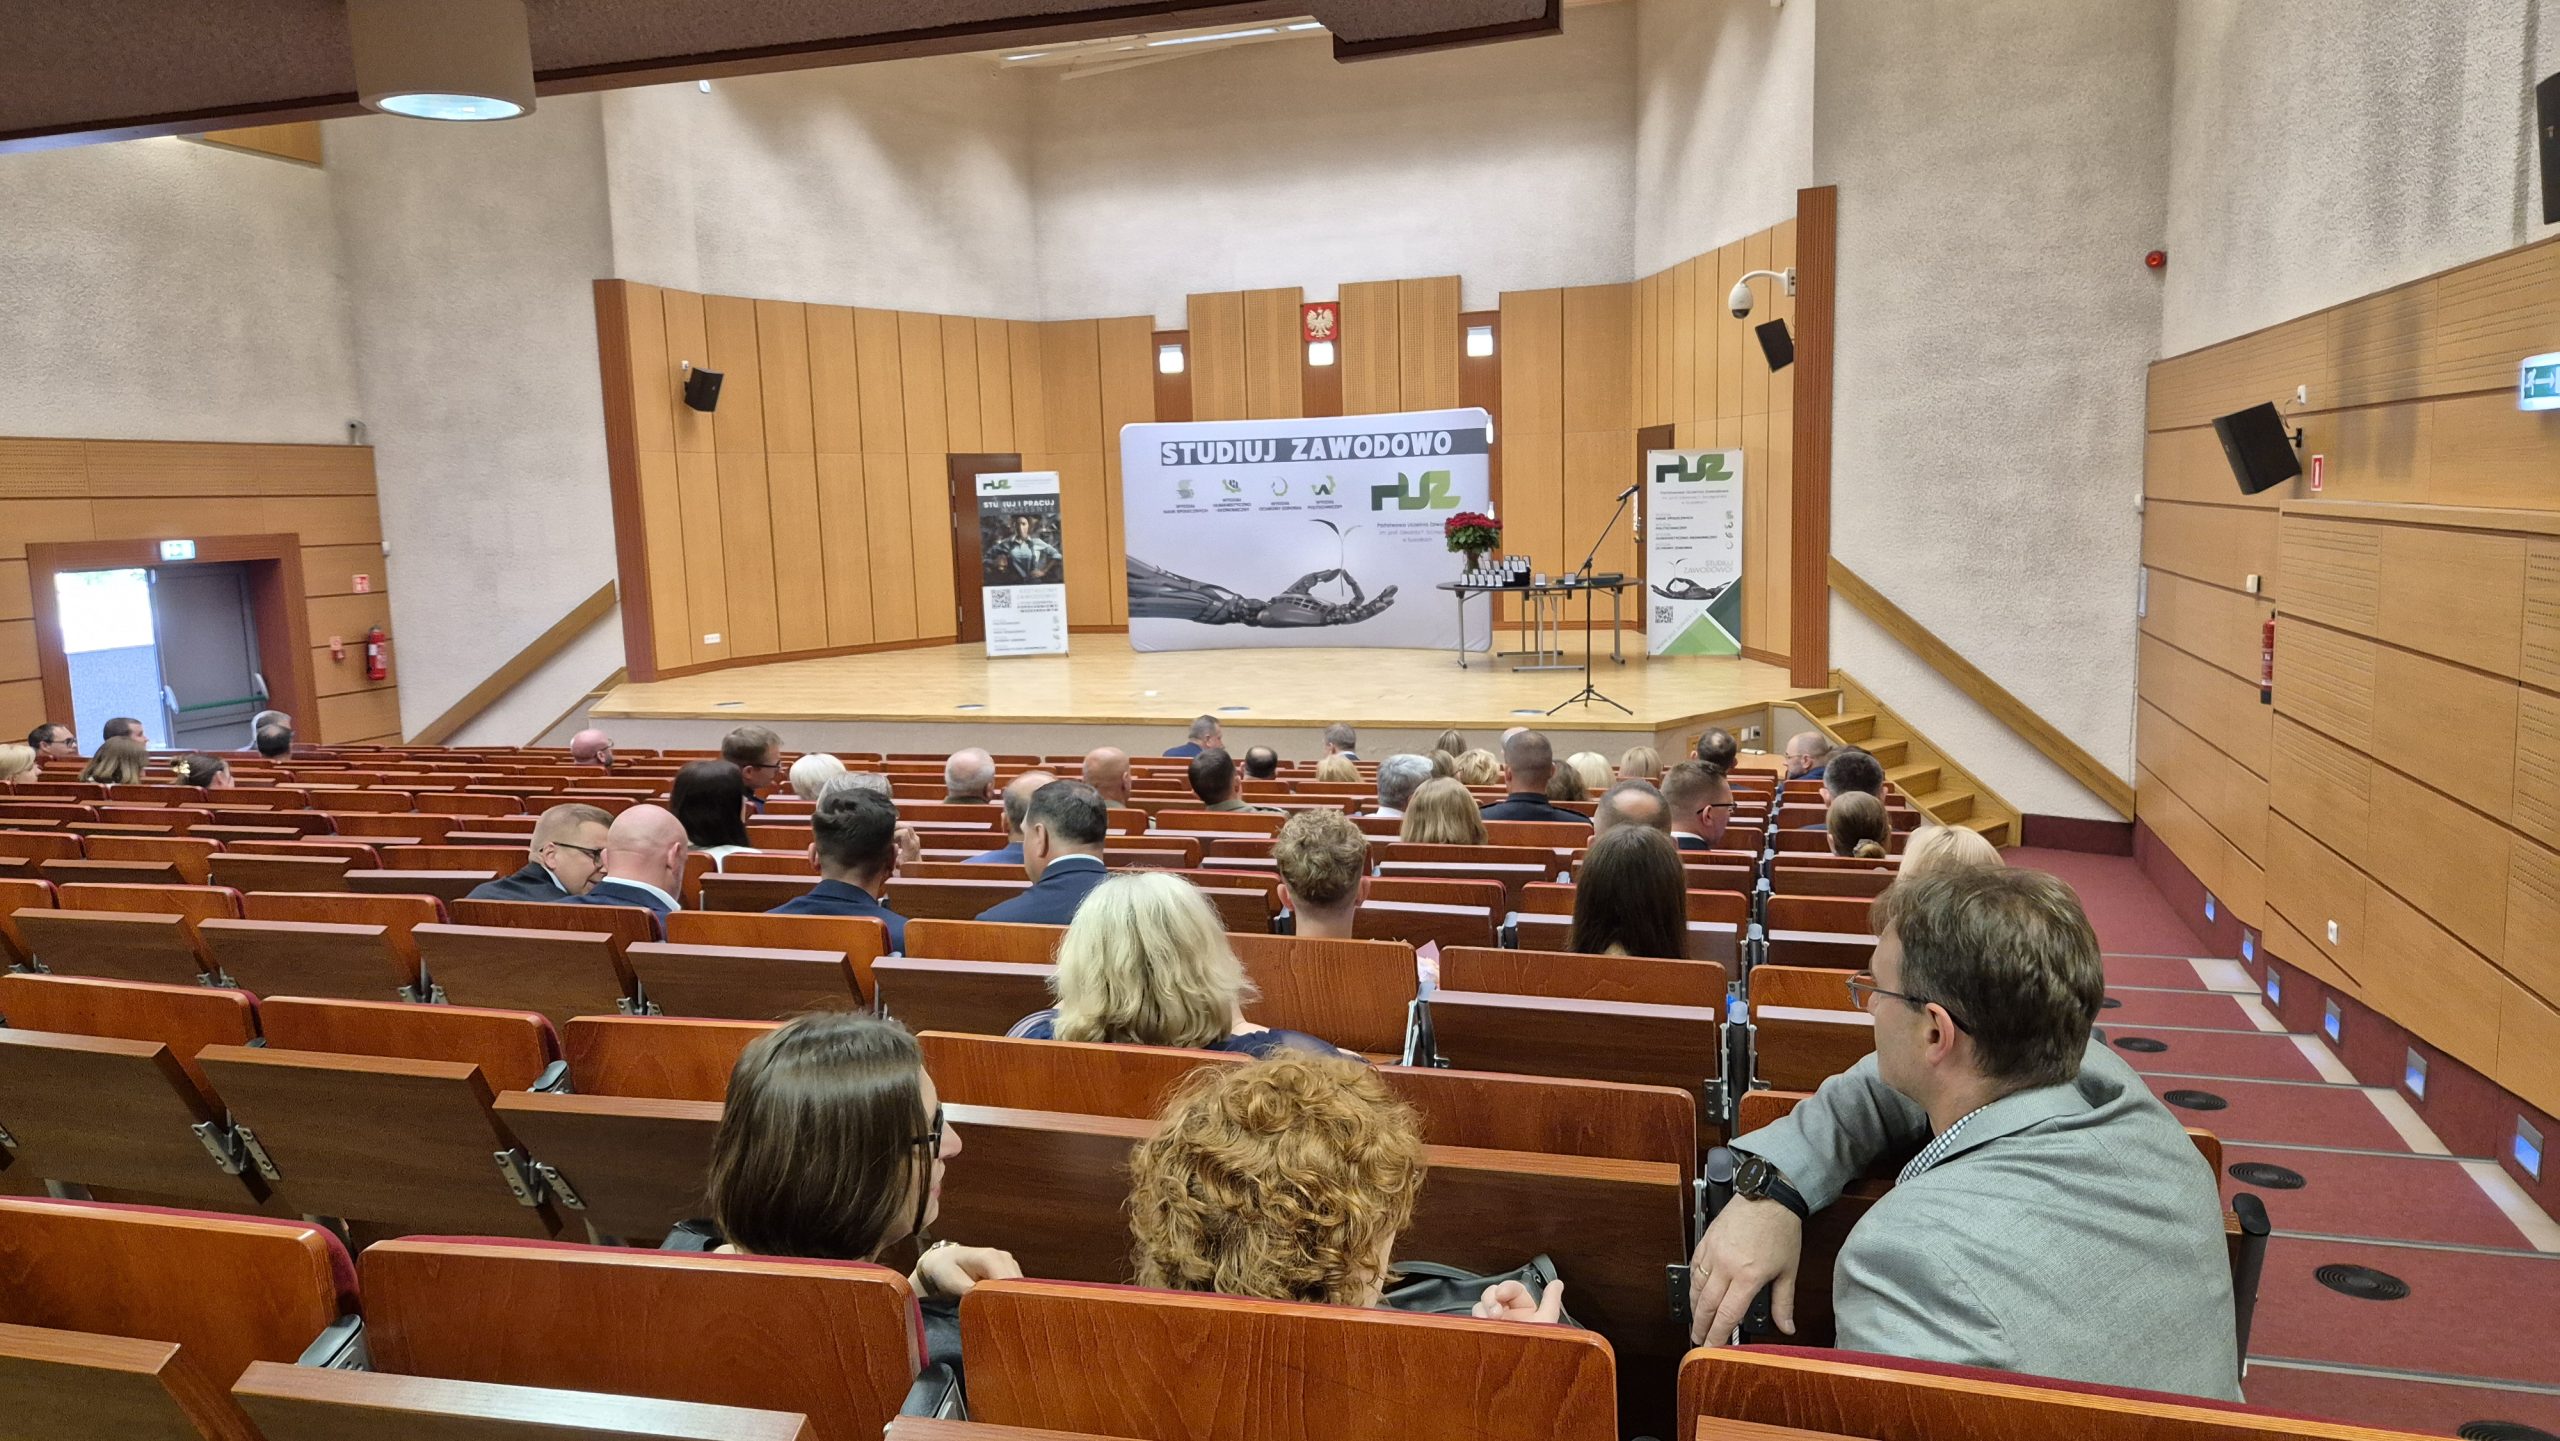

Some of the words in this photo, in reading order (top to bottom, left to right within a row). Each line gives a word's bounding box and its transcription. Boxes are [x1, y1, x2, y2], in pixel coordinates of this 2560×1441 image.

[1162, 439, 1277, 465] STUDIUJ
[1291, 430, 1452, 461] ZAWODOWO
[983, 500, 1016, 509] STUIUJ
[1023, 499, 1055, 507] PRACUJ
